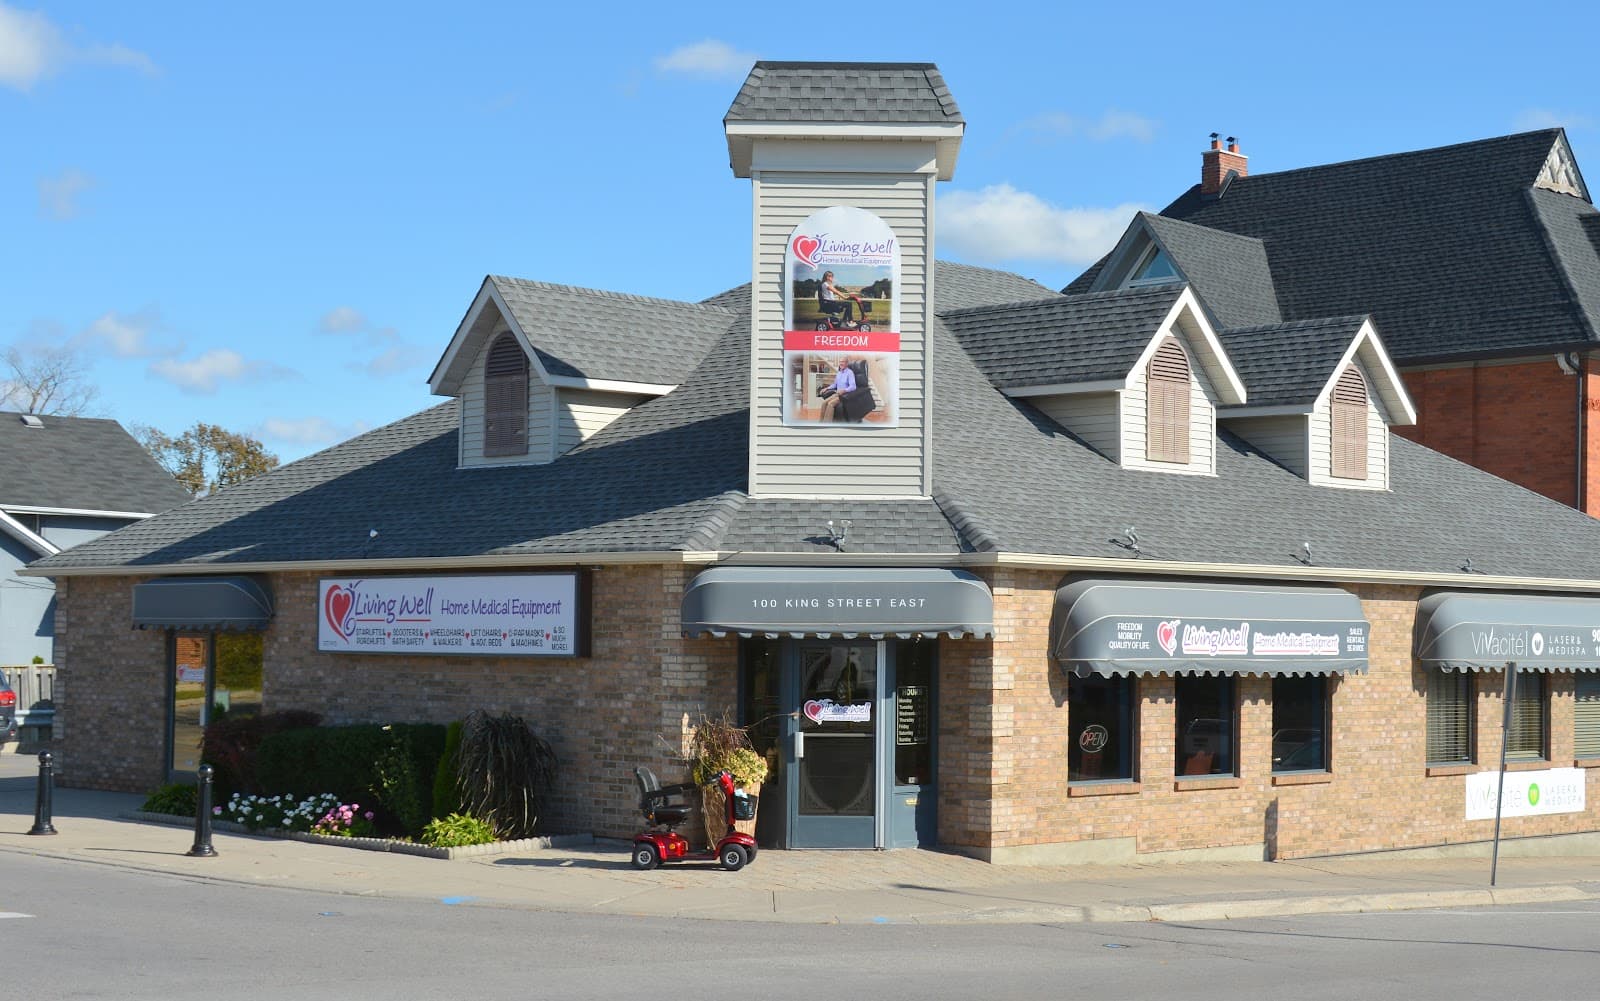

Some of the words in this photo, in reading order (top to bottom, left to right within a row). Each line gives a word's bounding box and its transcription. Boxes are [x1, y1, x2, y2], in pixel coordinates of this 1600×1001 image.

[822, 240, 860, 257] Living
[863, 239, 894, 253] Well
[864, 258, 892, 266] Equipment
[814, 335, 868, 347] FREEDOM
[355, 594, 396, 624] Living
[400, 587, 434, 615] Well
[441, 599, 470, 616] Home
[471, 599, 510, 615] Medical
[512, 599, 561, 619] Equipment
[752, 599, 777, 608] 100
[785, 599, 819, 608] KING
[827, 599, 882, 608] STREET
[890, 598, 926, 608] EAST
[1117, 622, 1143, 631] FREEDOM
[1349, 627, 1363, 635] SALES
[393, 628, 418, 636] SCOOTERS
[430, 628, 465, 637] WHEELCHAIRS
[471, 628, 481, 636] LIFT
[482, 628, 502, 637] CHAIRS
[525, 629, 544, 638] MASKS
[1118, 631, 1142, 640] MOBILITY
[406, 637, 424, 646] SAFETY
[438, 638, 462, 646] WALKERS
[488, 638, 502, 647] BEDS
[1183, 625, 1219, 653] Living
[1222, 623, 1248, 647] Well
[1255, 634, 1277, 648] Home
[1277, 633, 1305, 648] Medical
[1305, 634, 1339, 651] Equipment
[1346, 636, 1365, 644] RENTALS
[1549, 635, 1575, 645] LASER
[515, 639, 543, 648] MACHINES
[1108, 641, 1131, 650] QUALITY
[1131, 641, 1139, 649] OF
[1139, 641, 1151, 650] LIFE
[1346, 644, 1365, 652] SERVICE
[1548, 646, 1586, 656] MEDISPA
[1082, 731, 1106, 746] OPEN
